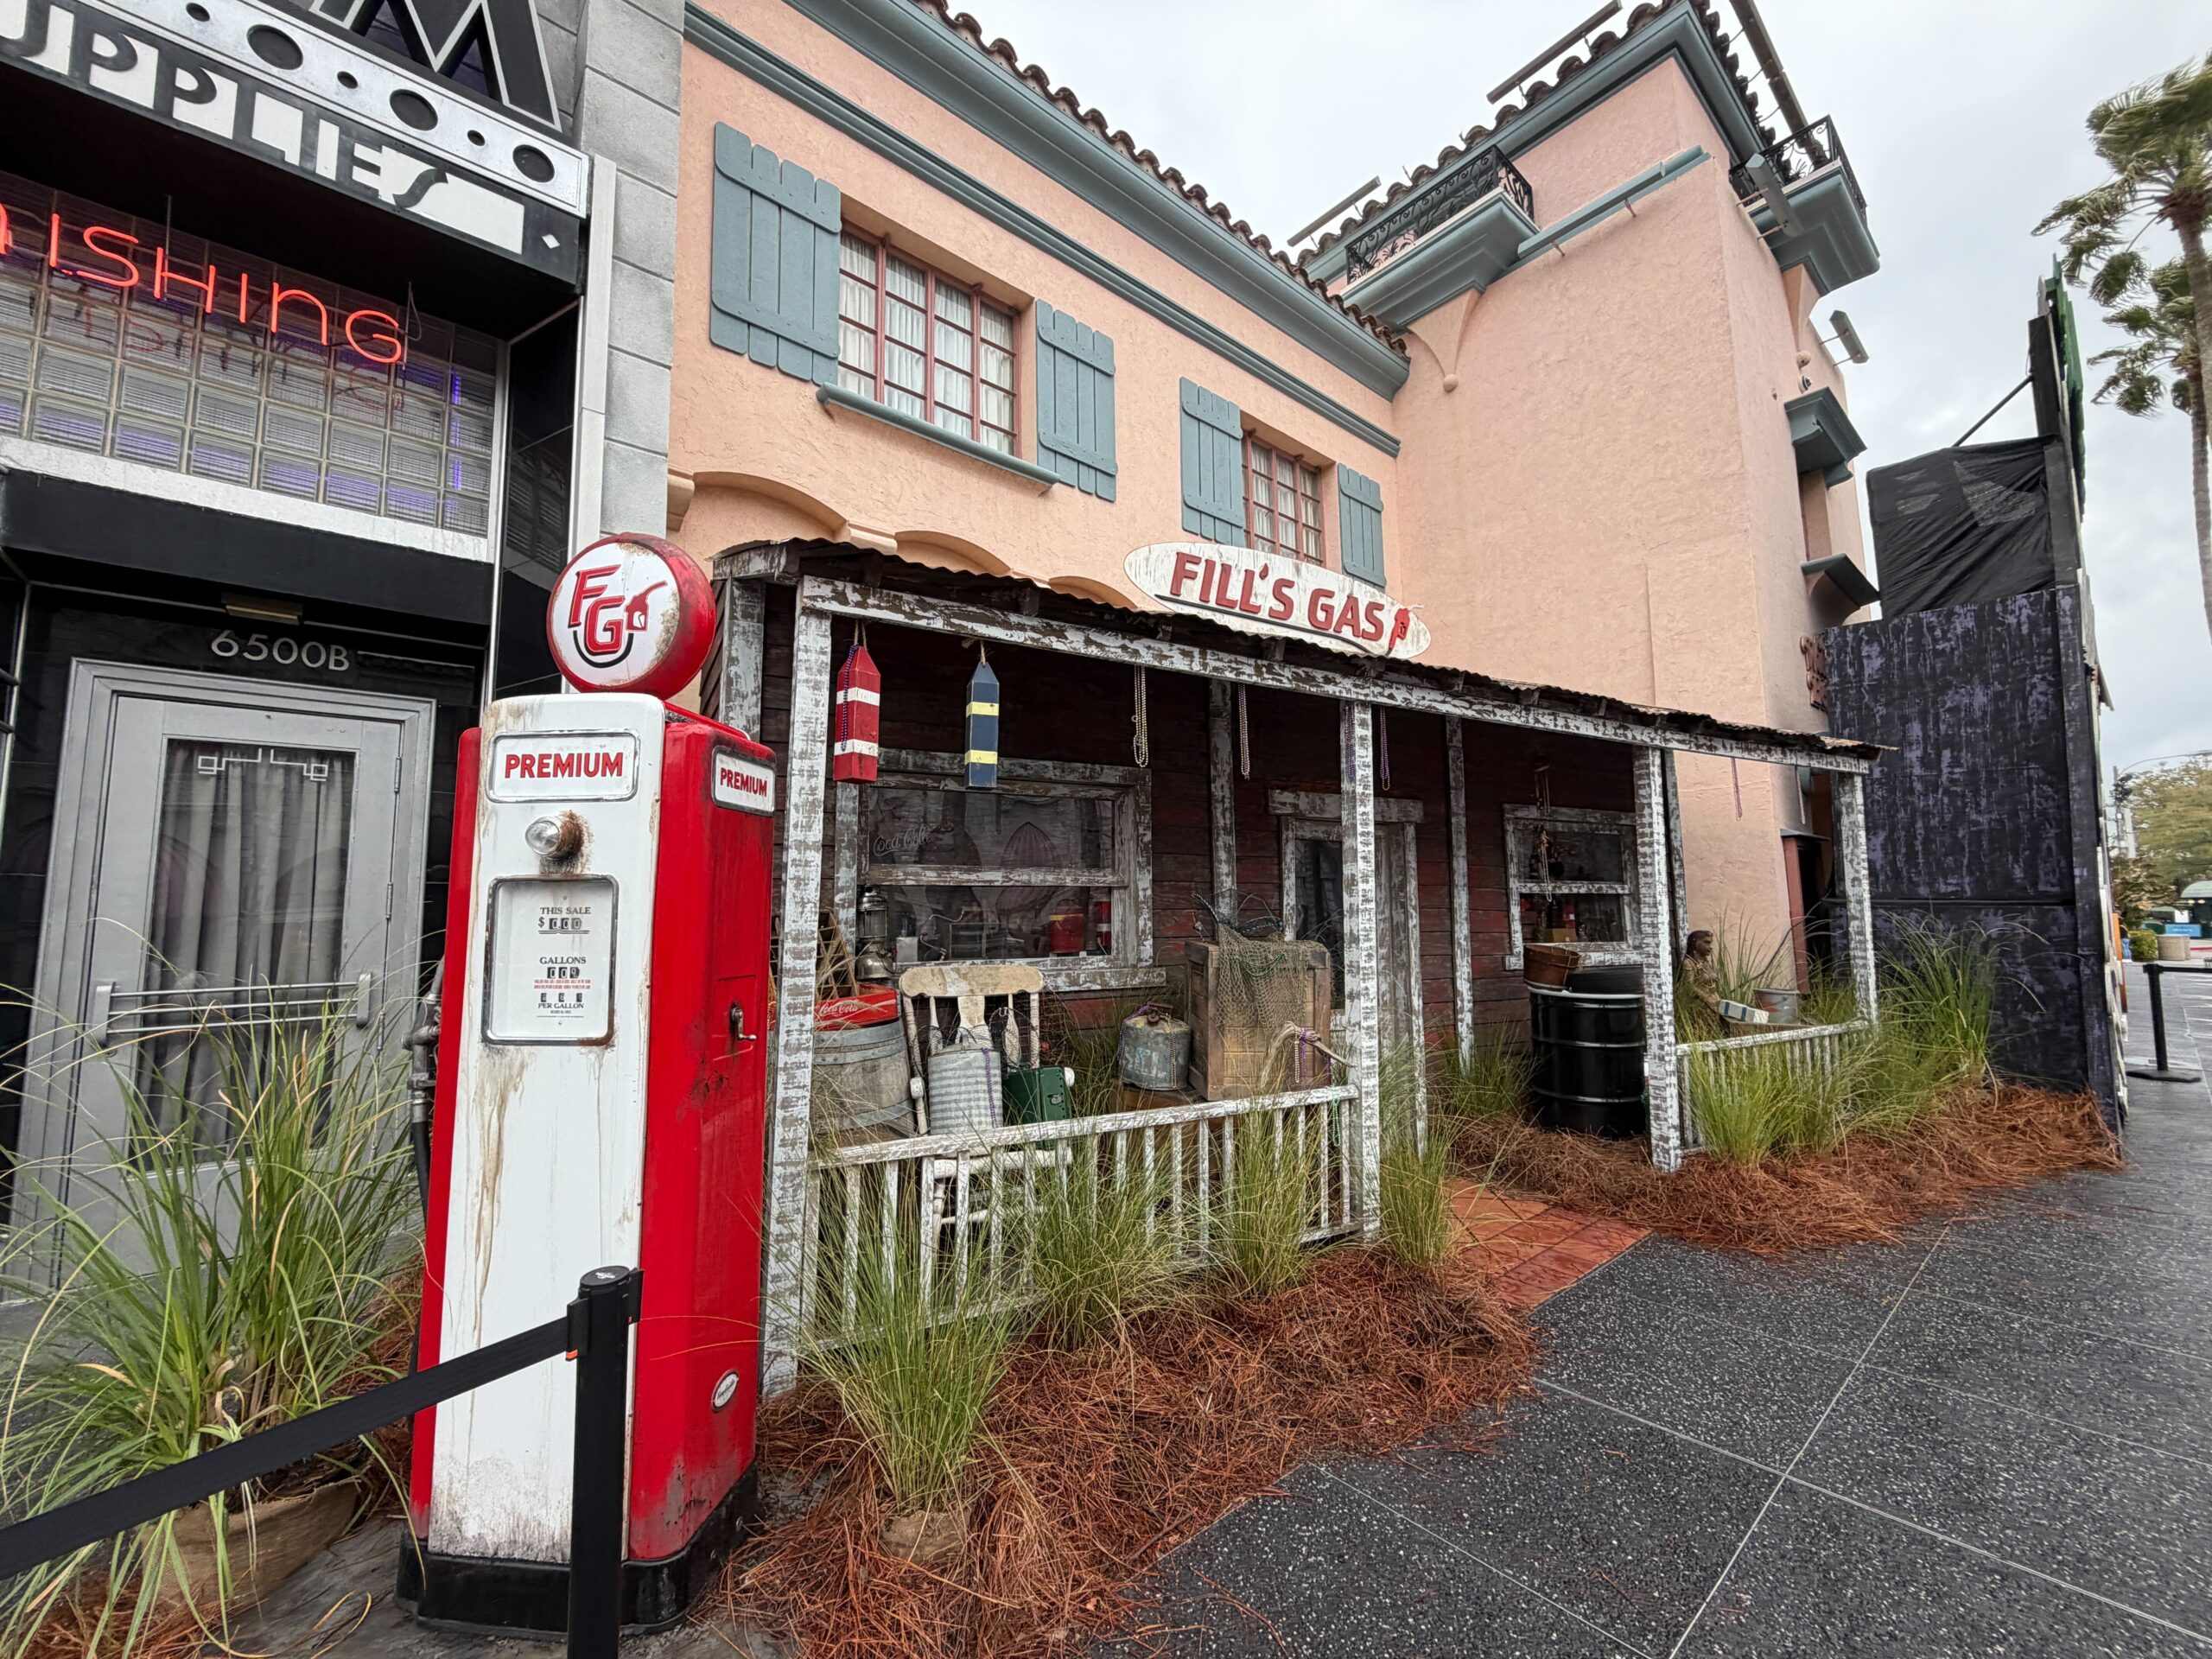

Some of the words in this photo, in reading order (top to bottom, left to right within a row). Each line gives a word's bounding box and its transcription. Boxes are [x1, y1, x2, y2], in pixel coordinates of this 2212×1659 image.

[1170, 551, 1295, 621] FILL'S
[1307, 588, 1384, 641] GAS
[211, 629, 350, 671] 6500B
[505, 752, 624, 779] PREMIUM
[720, 767, 767, 798] PREMIUM
[540, 906, 563, 915] THIS
[565, 906, 592, 915] SALE
